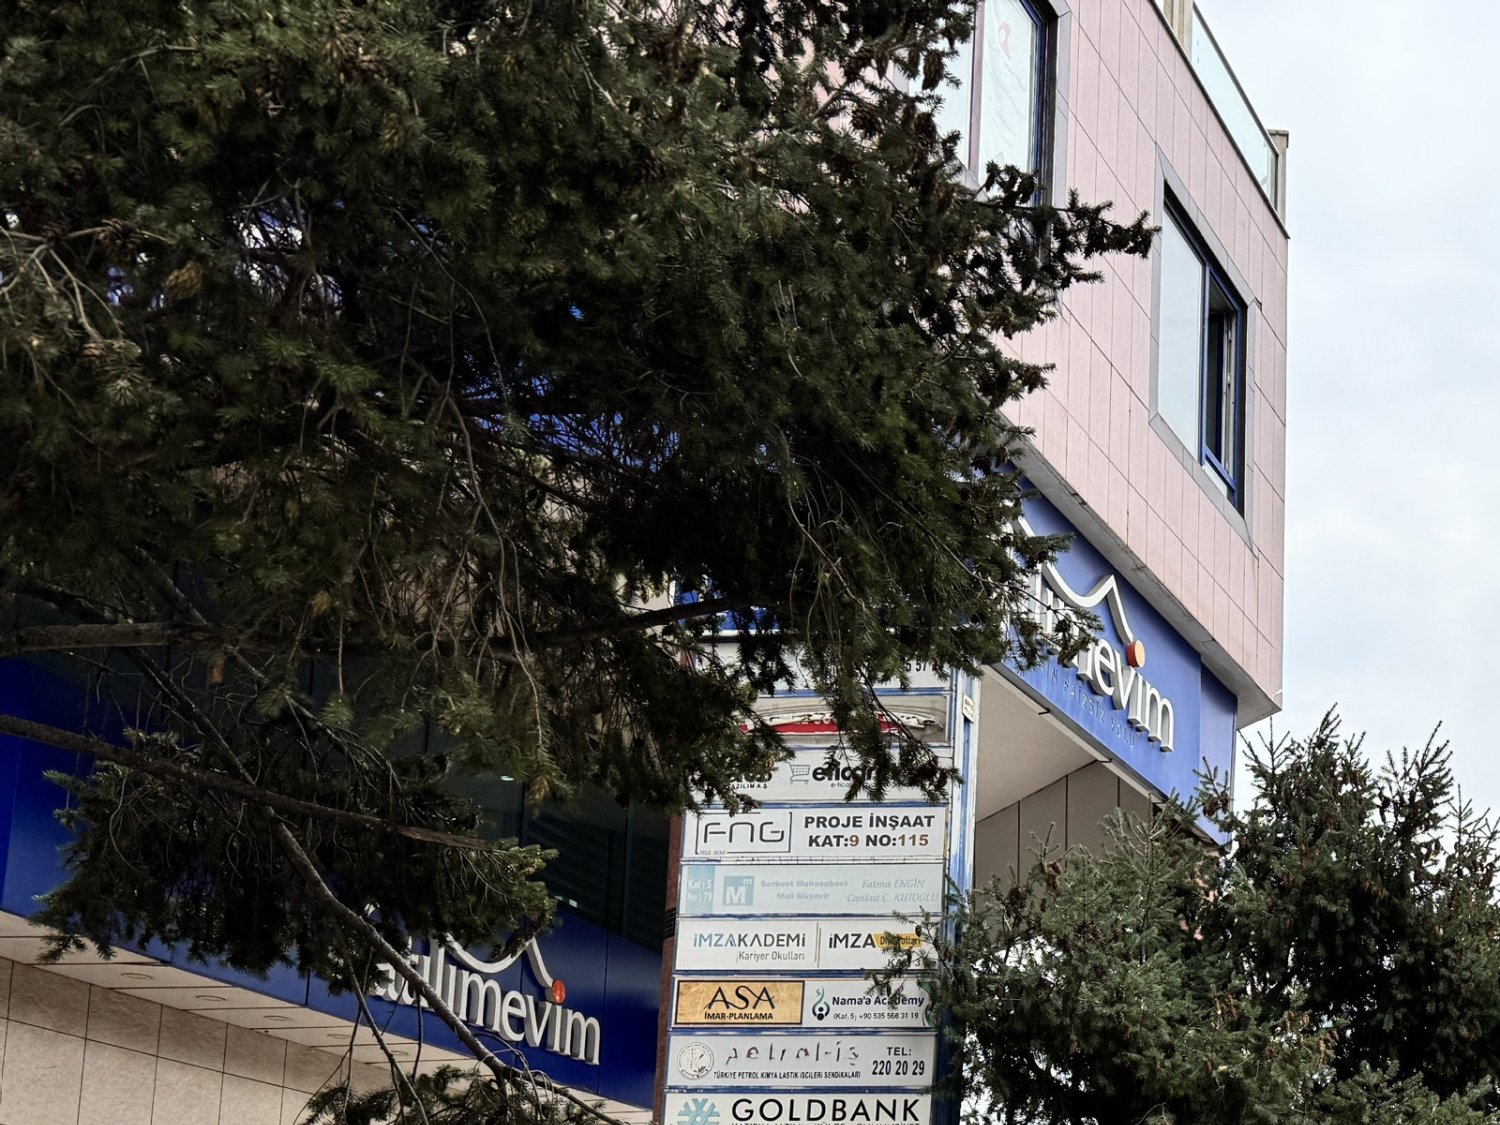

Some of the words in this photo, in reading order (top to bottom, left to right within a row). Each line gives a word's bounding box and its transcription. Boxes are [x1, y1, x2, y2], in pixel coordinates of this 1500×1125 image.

[803, 815, 862, 829] PROJE
[868, 812, 936, 830] İNŞAAT
[808, 834, 860, 847] KAT:9
[865, 833, 929, 847] NO:115
[862, 879, 892, 889] Fatma
[738, 950, 770, 963] Kariyer
[770, 950, 805, 961] Okulları
[704, 984, 777, 1010] ASA
[832, 995, 872, 1006] Nama'a
[704, 1010, 774, 1021] İMAR-PLANLAMA
[886, 1046, 912, 1056] TEL:
[872, 1059, 892, 1076] 220
[893, 1059, 910, 1076] 20
[911, 1059, 925, 1076] 29
[738, 1071, 759, 1079] PETROL
[731, 1098, 921, 1122] GOLDBANK
